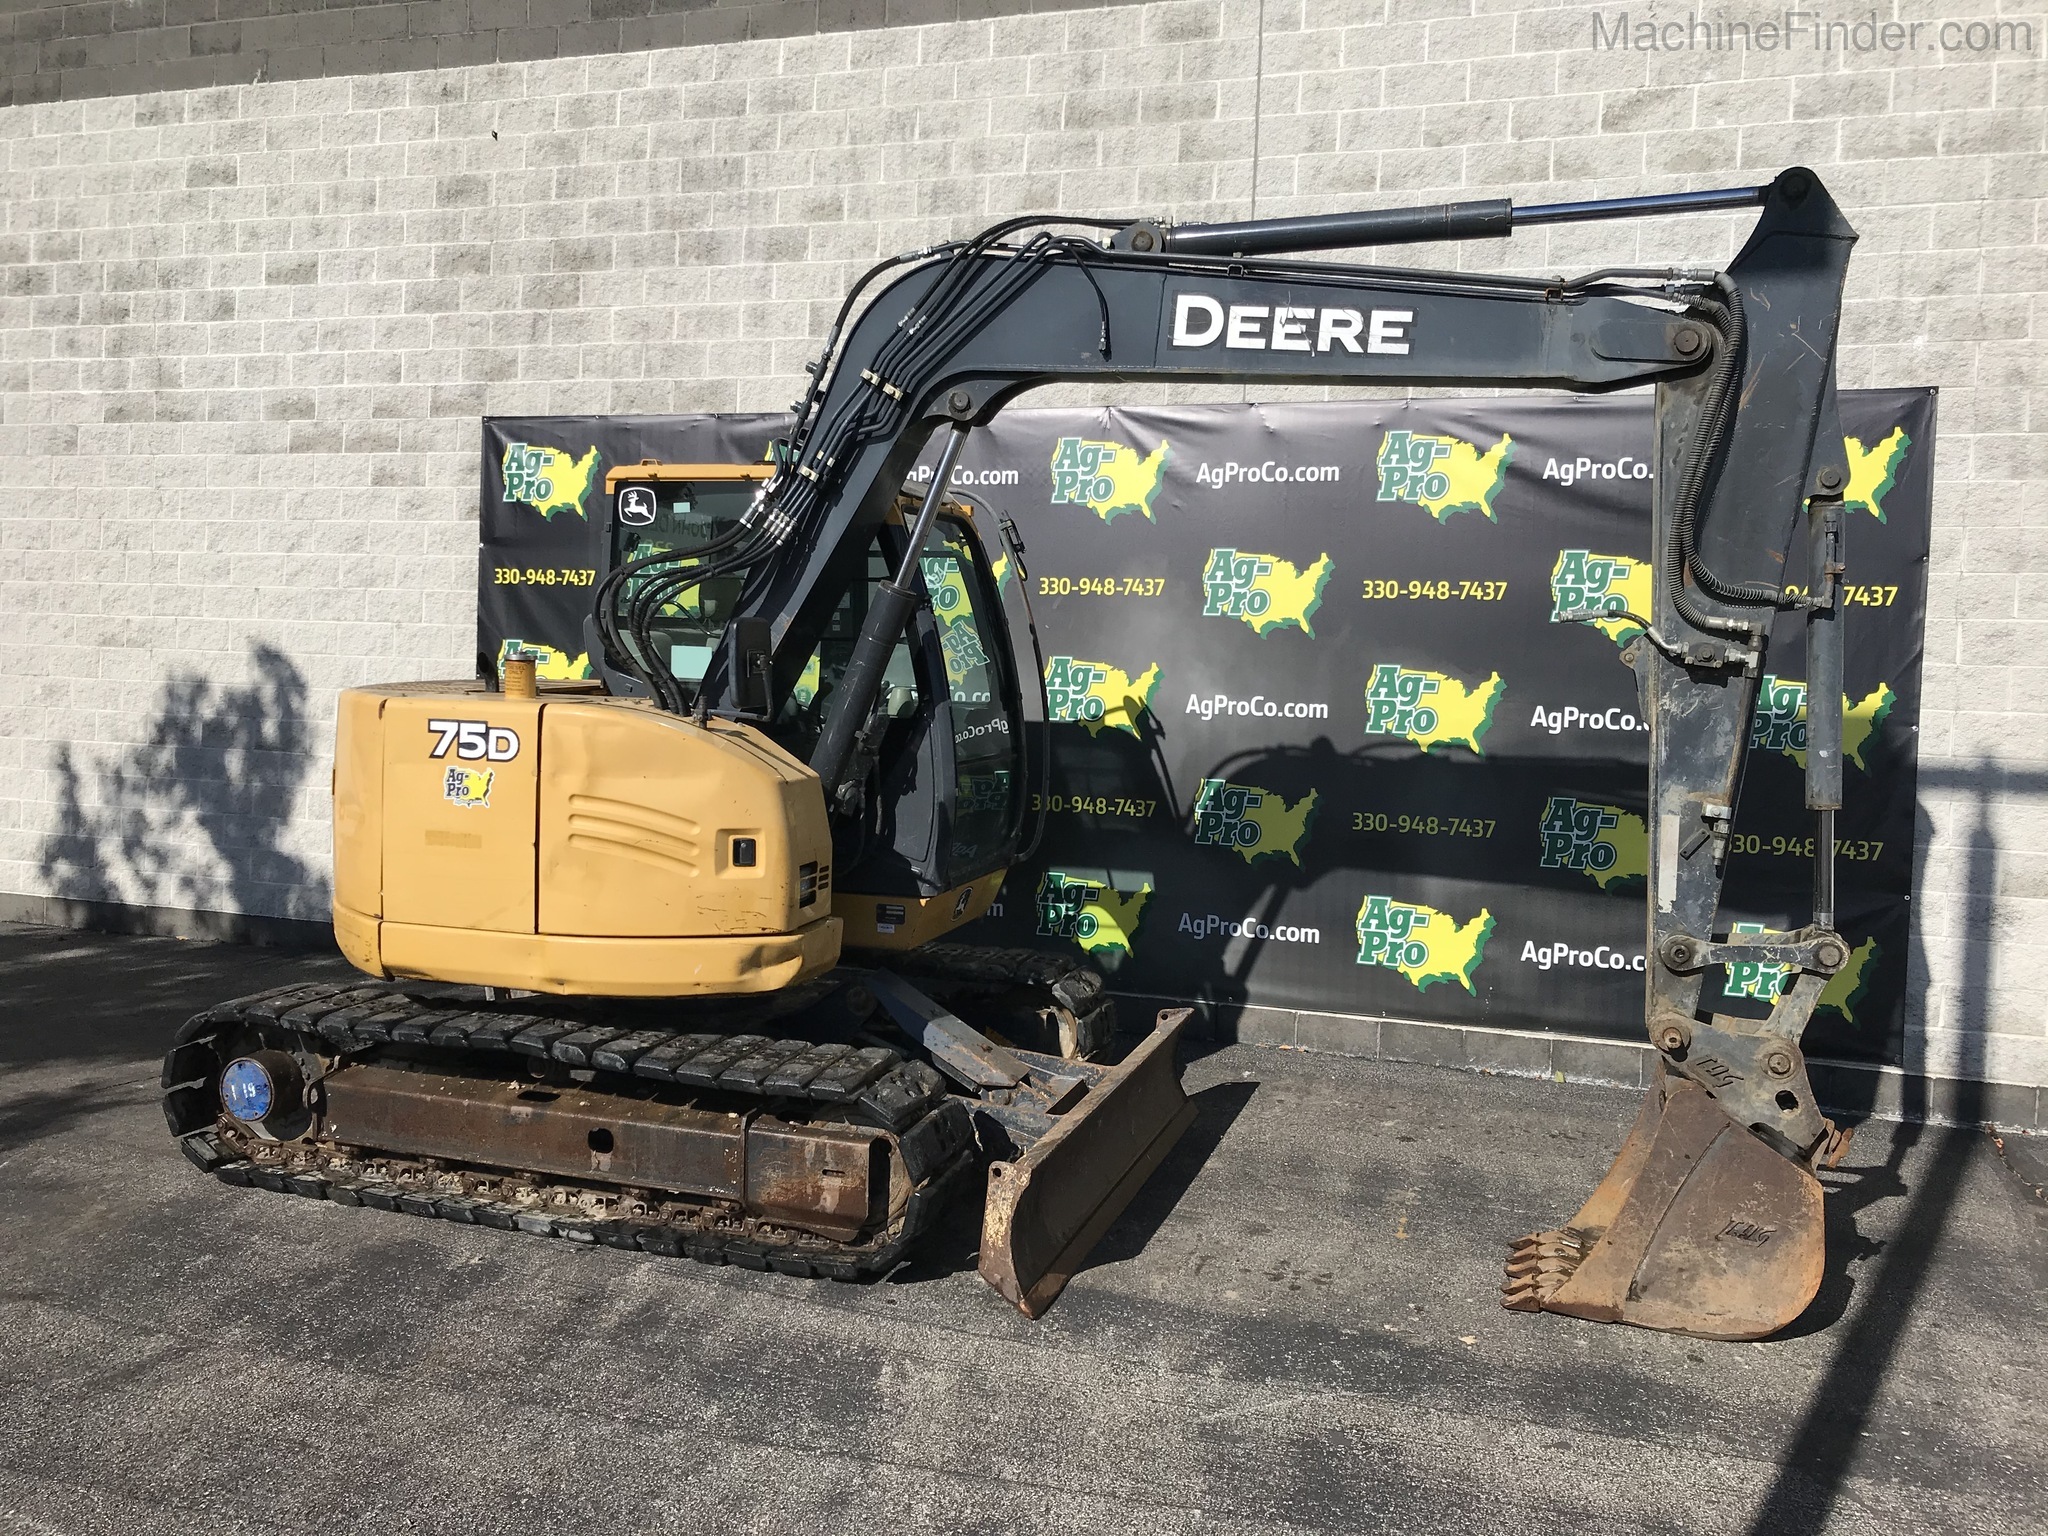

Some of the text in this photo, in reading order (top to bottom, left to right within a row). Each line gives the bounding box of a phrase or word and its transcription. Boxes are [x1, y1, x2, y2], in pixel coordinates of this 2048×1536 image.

[1172, 294, 1414, 355] DEERE
[503, 442, 554, 478] Ag-
[1053, 437, 1117, 475] Ag-
[1379, 431, 1452, 471] Ag-
[502, 472, 554, 502] Pro
[907, 465, 1019, 485] PCo.com
[1051, 468, 1115, 504] Pro
[1196, 462, 1340, 489] AgProCo.com
[1376, 464, 1450, 503] Pro
[1542, 457, 1655, 486] AgProCo.
[494, 568, 596, 586] 330-948-7437
[1206, 548, 1273, 585] Ag-
[1553, 549, 1631, 594] Ag-
[1039, 578, 1165, 597] 330-948-7437
[1202, 580, 1271, 616] Pro
[1363, 580, 1508, 601] 330-948-7437
[1047, 656, 1107, 698] Ag-
[1369, 664, 1440, 702] Ag-
[1047, 688, 1105, 721] Pro
[1185, 694, 1329, 721] AgProCo.com
[1365, 698, 1438, 735] Pro
[1530, 705, 1650, 735] AgProCo.
[427, 718, 521, 762] 75D
[446, 768, 470, 786] Ag-
[446, 782, 470, 797] Pro
[1198, 779, 1263, 815] Ag-
[1195, 811, 1262, 847] Pro
[1352, 813, 1496, 839] 330-948-7437
[1545, 798, 1619, 834] Ag-
[1540, 832, 1618, 870] Pro
[1728, 834, 1885, 862] 30-9487437
[1038, 872, 1099, 913] Ag-
[1036, 902, 1098, 938] Pro
[1178, 912, 1320, 944] AgProCo.com
[1358, 895, 1431, 939] Ag-
[1356, 929, 1430, 968] Pro
[1520, 940, 1648, 971] AgProCo.c
